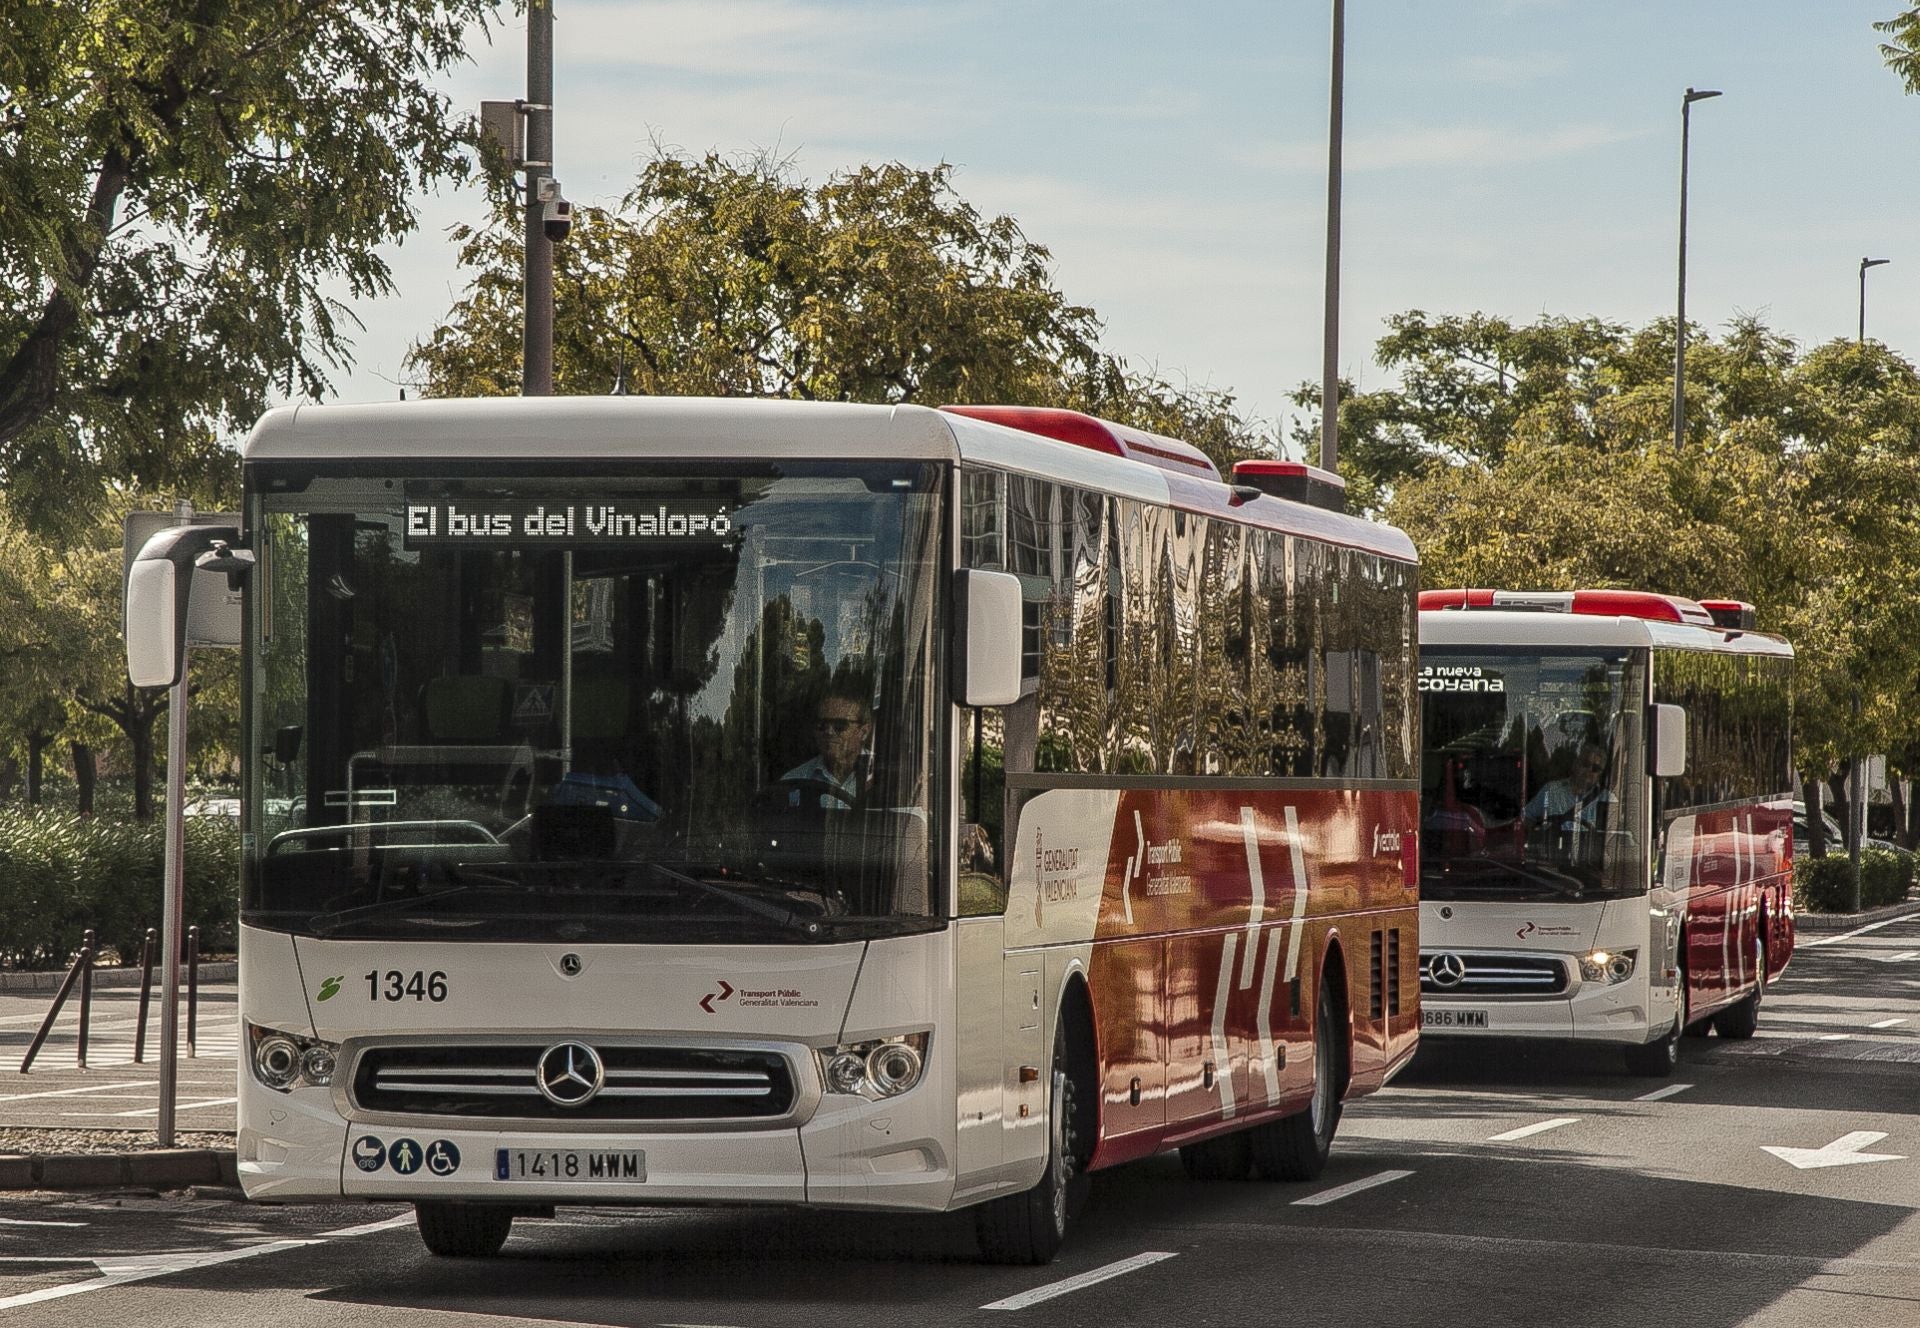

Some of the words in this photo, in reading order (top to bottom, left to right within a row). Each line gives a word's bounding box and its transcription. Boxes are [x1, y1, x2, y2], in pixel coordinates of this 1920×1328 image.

[408, 506, 437, 536] El
[449, 506, 512, 536] bus
[524, 506, 574, 536] del
[586, 506, 731, 536] Vinalopó
[1437, 666, 1482, 677] nueva
[1418, 678, 1504, 692] coyana
[1043, 848, 1079, 872] GENERALITAT
[1043, 879, 1078, 901] VALENCIANA
[365, 970, 448, 1003] 1346
[740, 989, 777, 999] Transport
[777, 988, 802, 998] Públic
[739, 998, 779, 1007] Generalitat
[780, 998, 819, 1007] Valenciana
[1456, 1011, 1485, 1025] MWM
[517, 1153, 579, 1177] 1418
[589, 1153, 638, 1178] MWM
